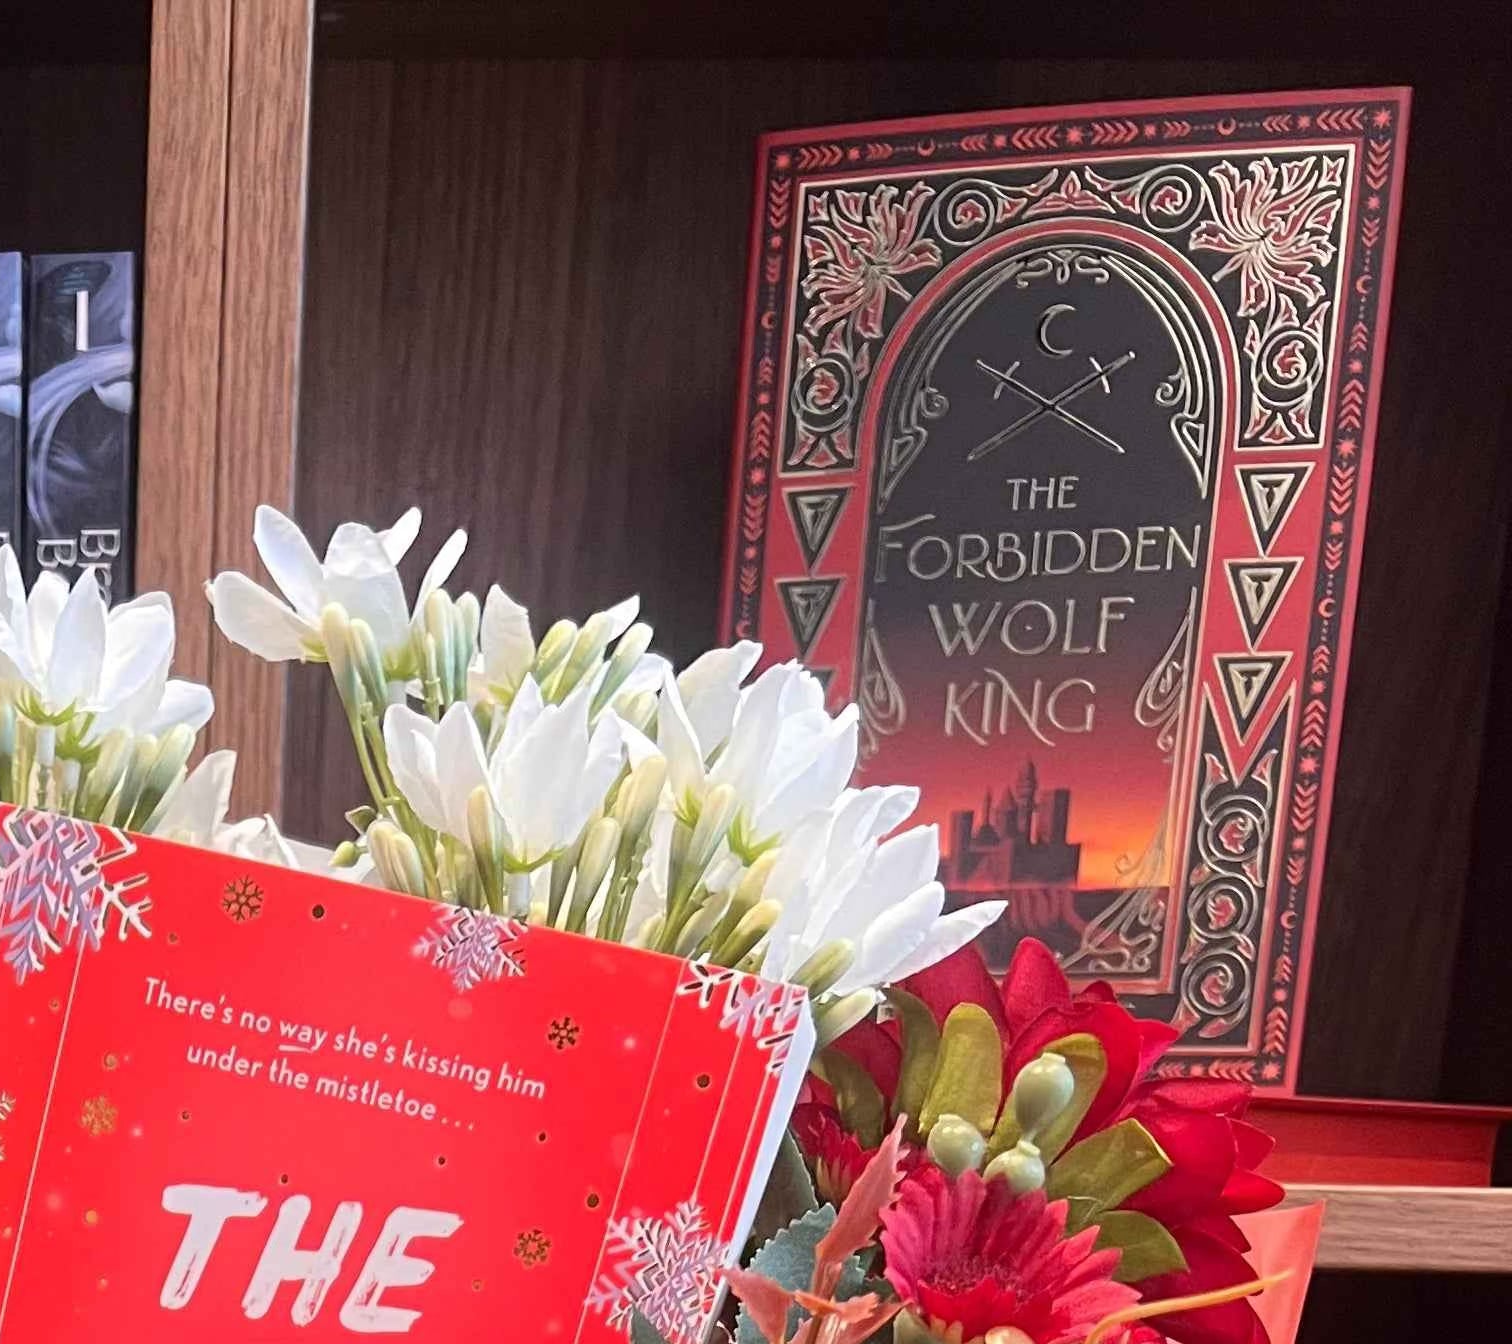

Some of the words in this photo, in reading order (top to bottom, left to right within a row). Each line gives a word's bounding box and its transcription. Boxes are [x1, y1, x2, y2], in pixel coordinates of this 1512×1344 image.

[1006, 476, 1080, 511] THE
[874, 513, 1202, 582] FORBIDDEN
[928, 597, 1135, 657] WOLF
[944, 667, 1097, 747] KING
[142, 976, 235, 1029] There's
[239, 1008, 274, 1035] no
[278, 1020, 329, 1053] way
[332, 1026, 399, 1065] she's
[401, 1038, 491, 1094] kissing
[496, 1062, 547, 1100] him
[186, 1042, 266, 1081] under
[269, 1056, 310, 1089] the
[159, 1184, 465, 1334] THE
